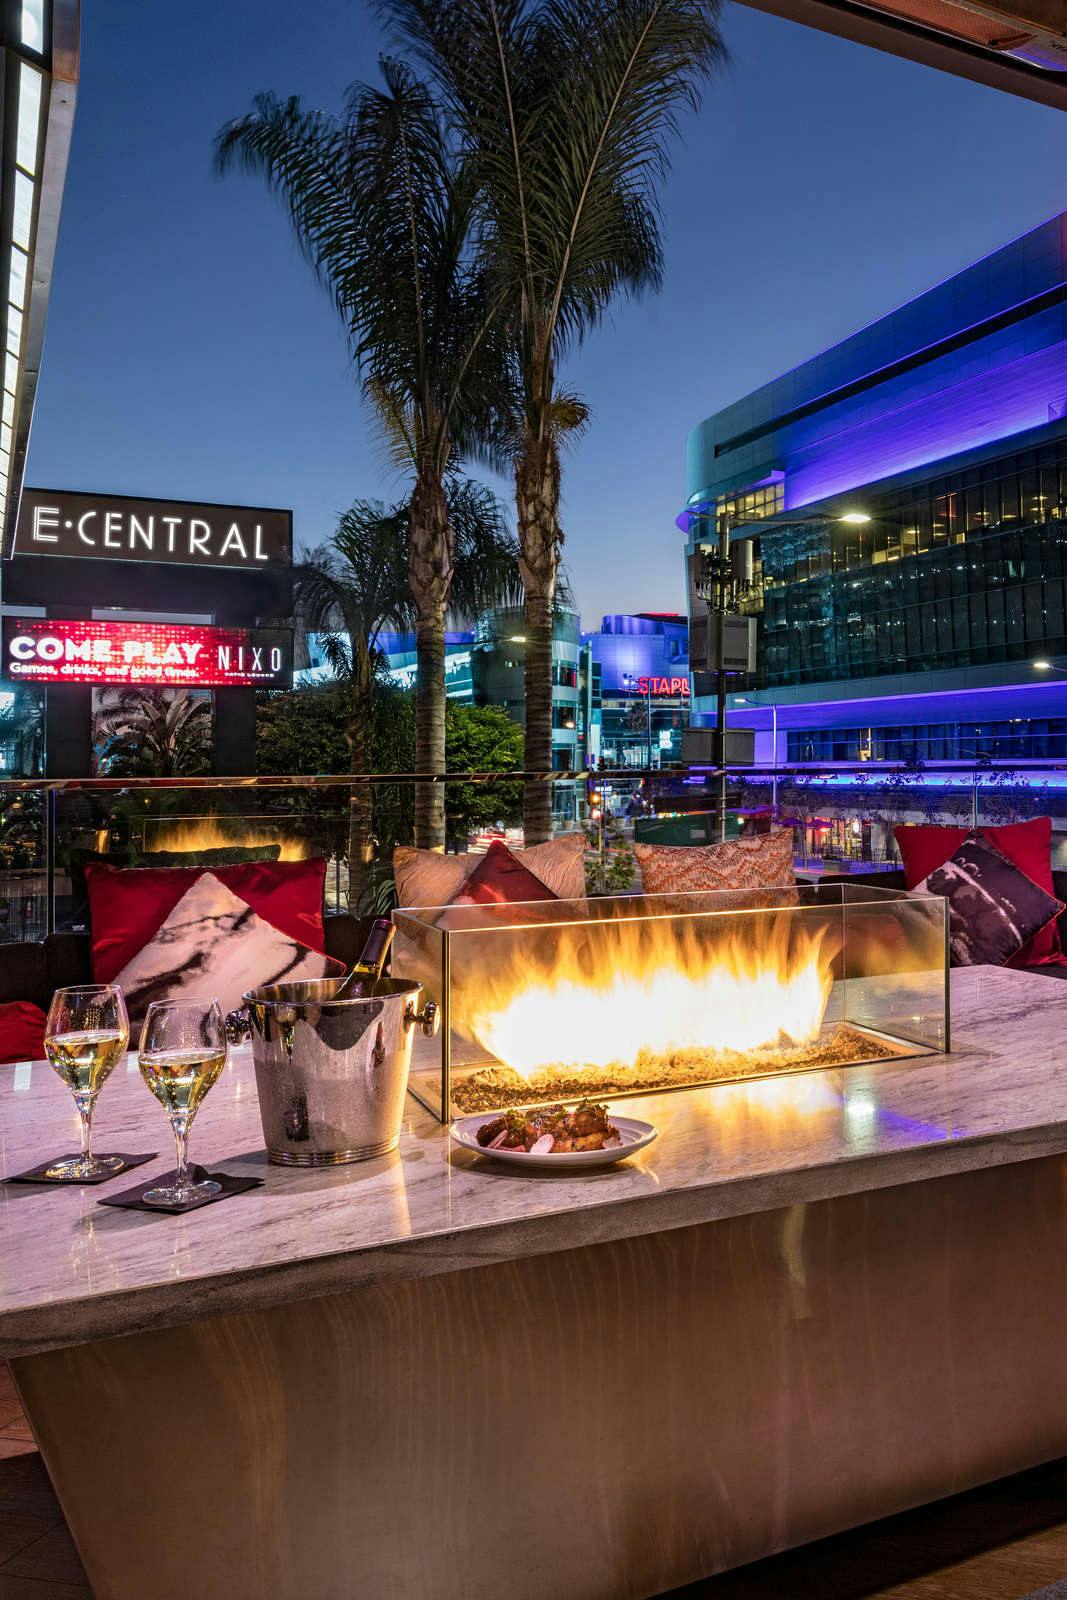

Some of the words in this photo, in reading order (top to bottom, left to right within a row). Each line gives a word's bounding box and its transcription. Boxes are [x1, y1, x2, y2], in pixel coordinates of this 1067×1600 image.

[9, 636, 112, 662] COME
[123, 640, 203, 664] PLAY
[218, 646, 281, 671] NIXO
[9, 662, 58, 675] Games,
[60, 664, 102, 676] drinks,
[105, 665, 129, 675] and
